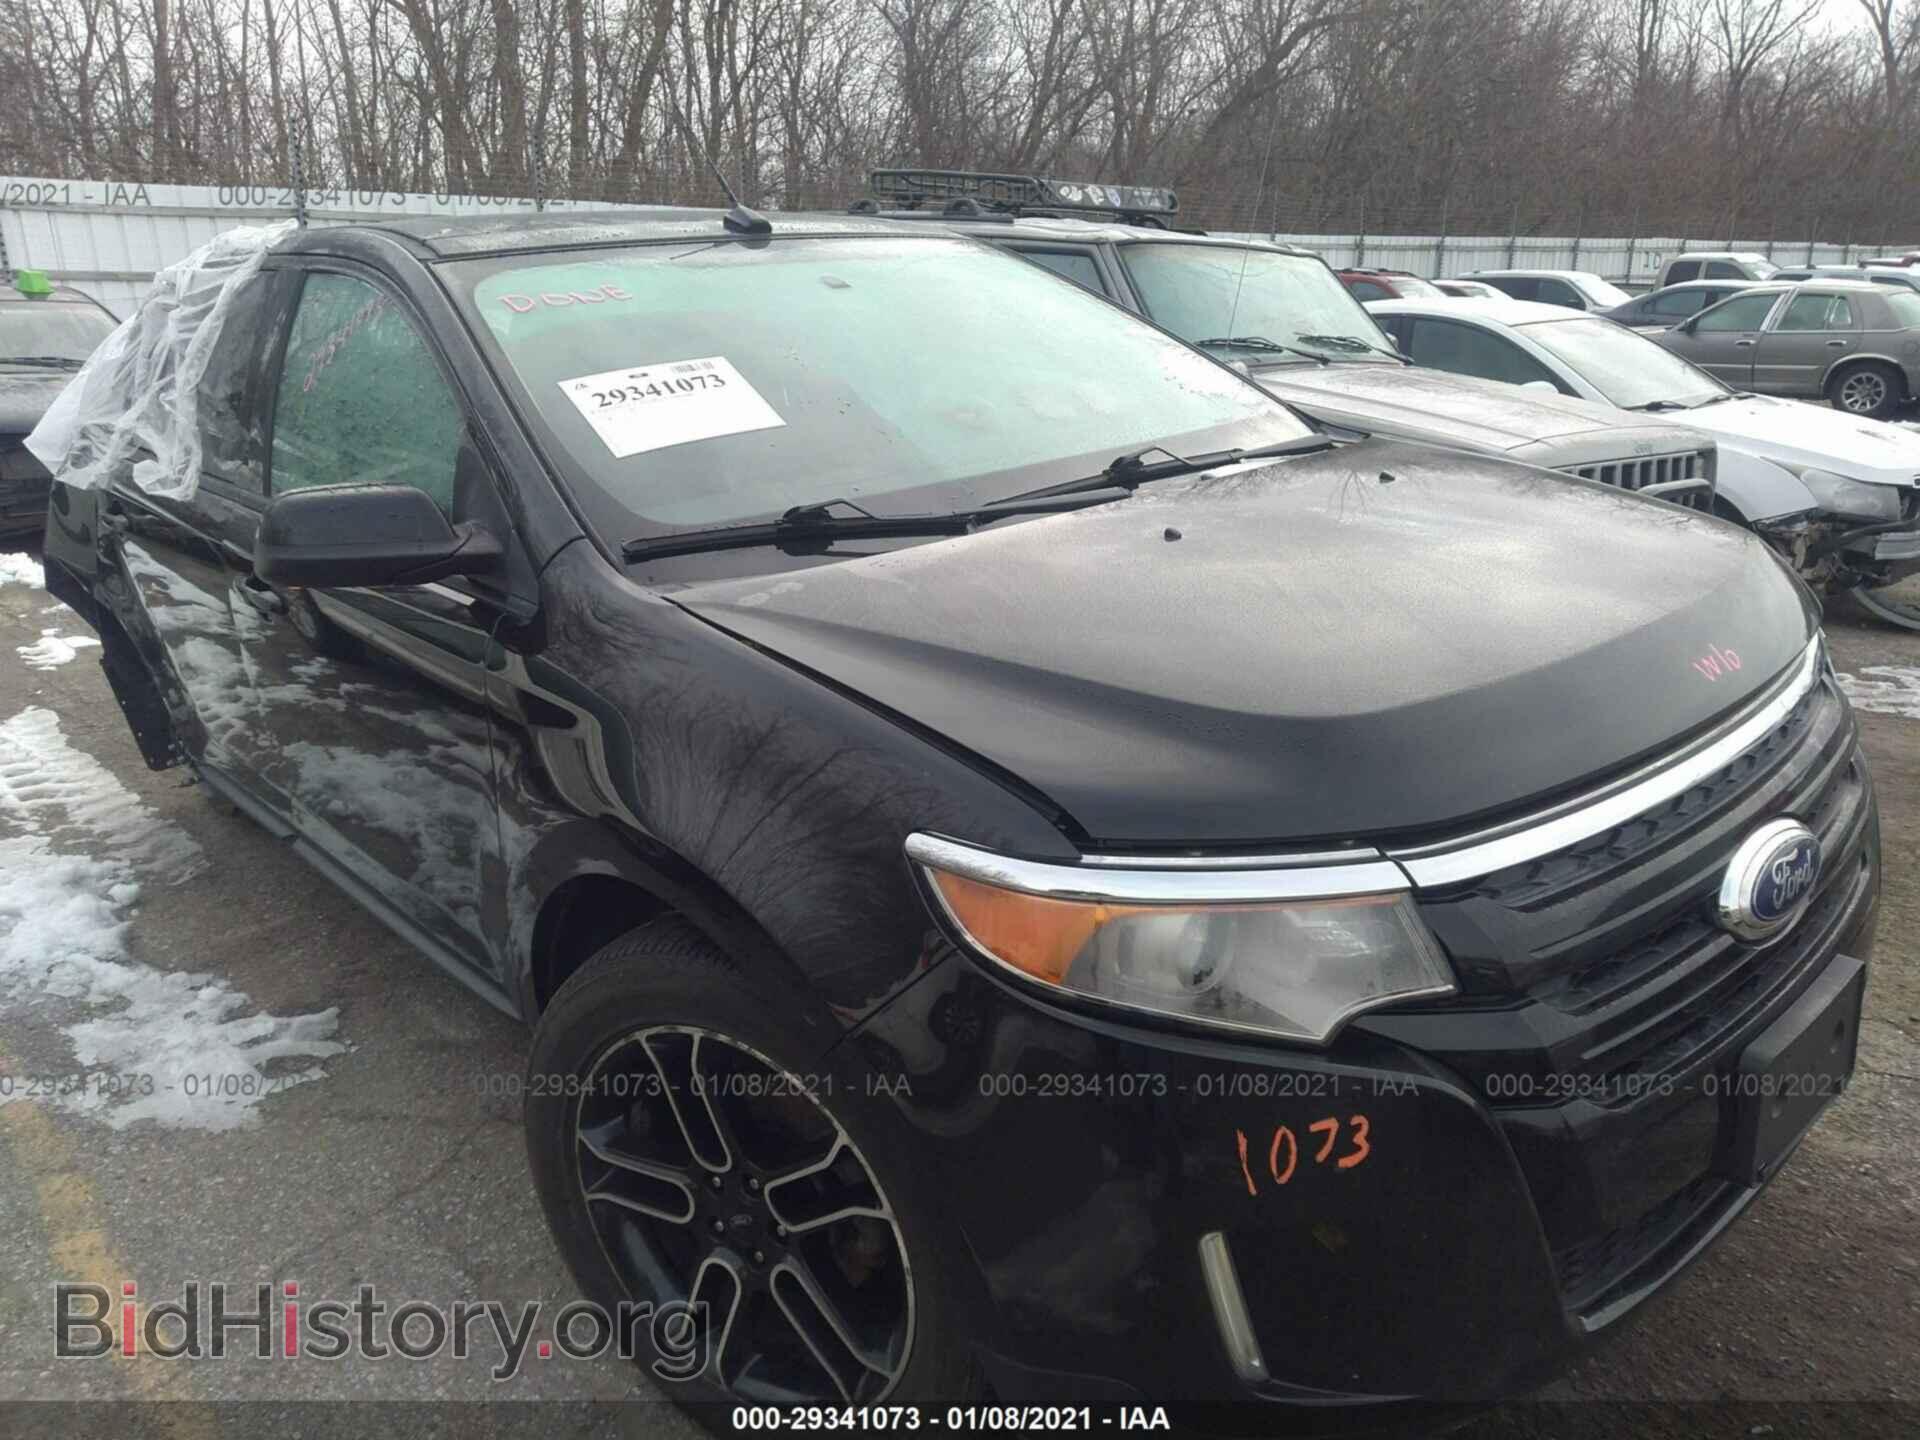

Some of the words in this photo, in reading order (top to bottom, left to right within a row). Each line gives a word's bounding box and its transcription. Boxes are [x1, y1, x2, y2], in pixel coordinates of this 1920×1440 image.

[591, 373, 726, 408] 29341073
[1771, 847, 1815, 910] Ford
[1236, 1114, 1372, 1196] 1073
